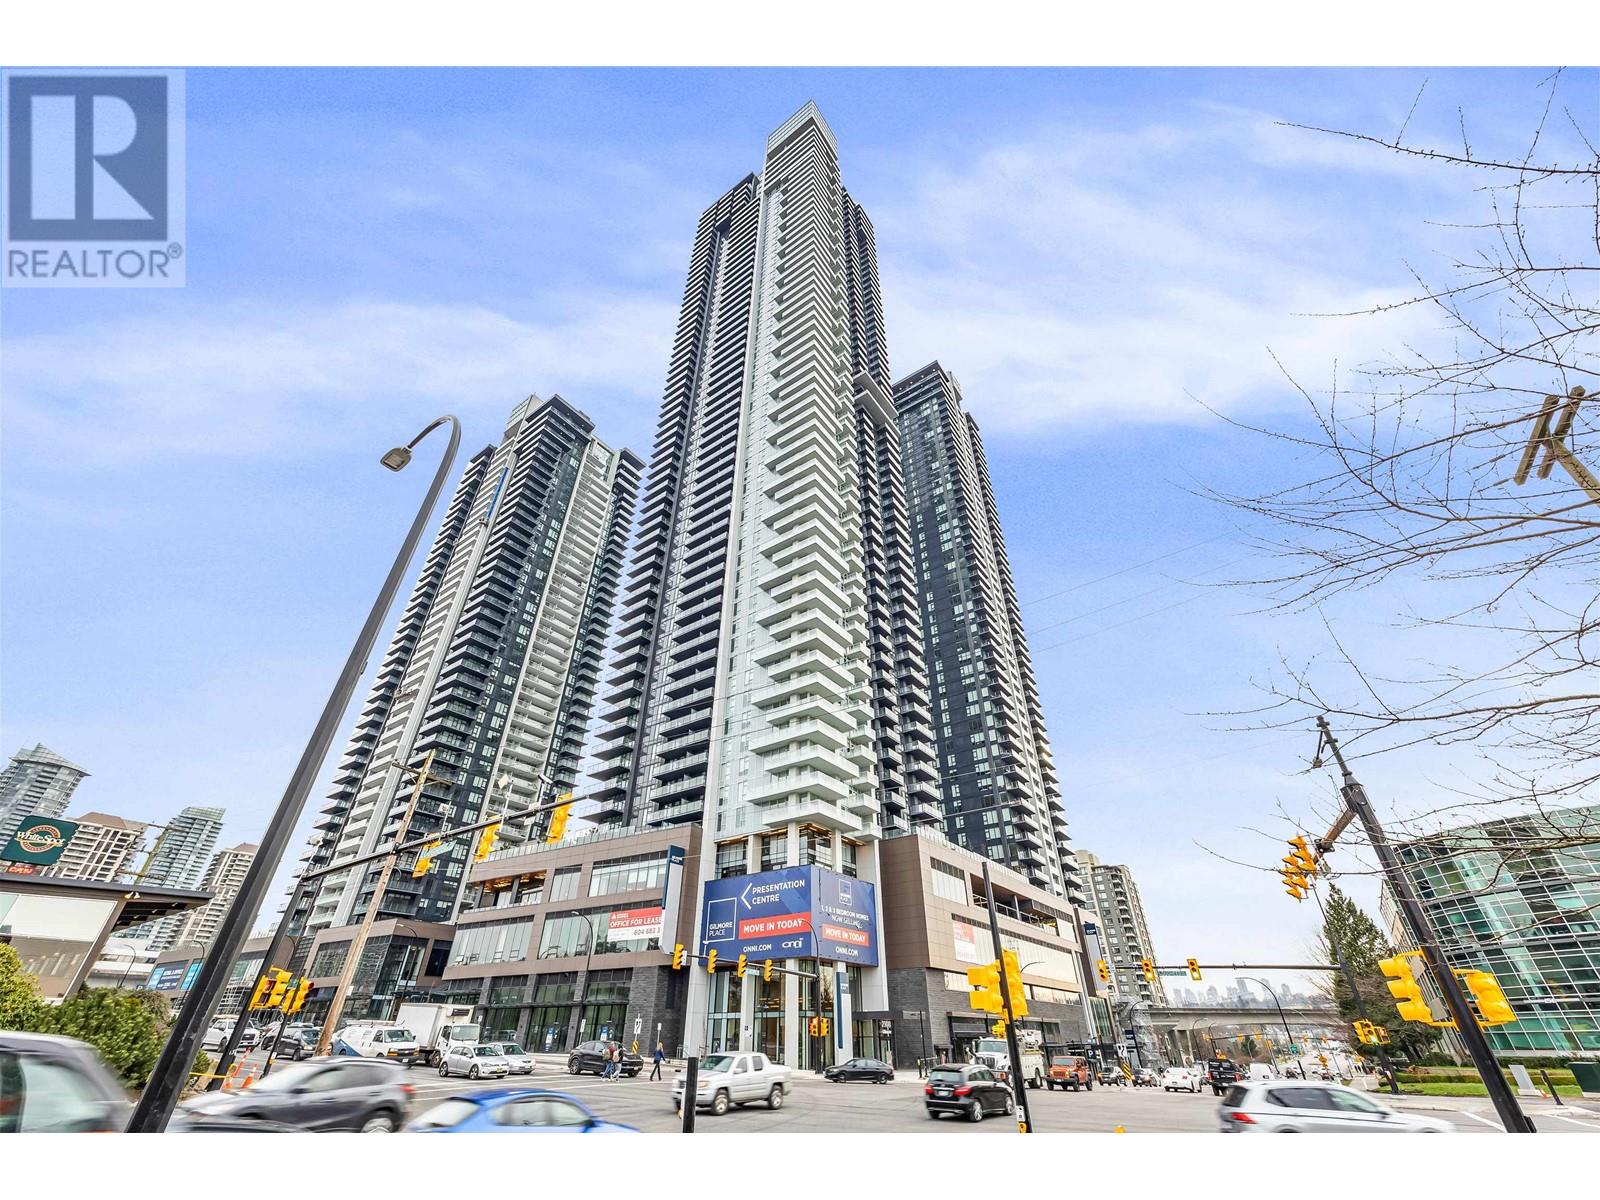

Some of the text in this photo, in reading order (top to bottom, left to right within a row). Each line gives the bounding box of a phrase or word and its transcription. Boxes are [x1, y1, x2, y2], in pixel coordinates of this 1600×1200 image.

[752, 879, 805, 895] PRESENTATION
[752, 893, 780, 905] CENTRE
[610, 919, 631, 928] OFFICE
[709, 921, 733, 930] GILMORE
[743, 918, 803, 934] MOVE IN TODAY
[709, 928, 726, 937] PLACE
[825, 927, 866, 943] MOVE IN TODAY
[743, 943, 772, 953] ONNI.COM
[835, 946, 859, 957] ONNI.COM
